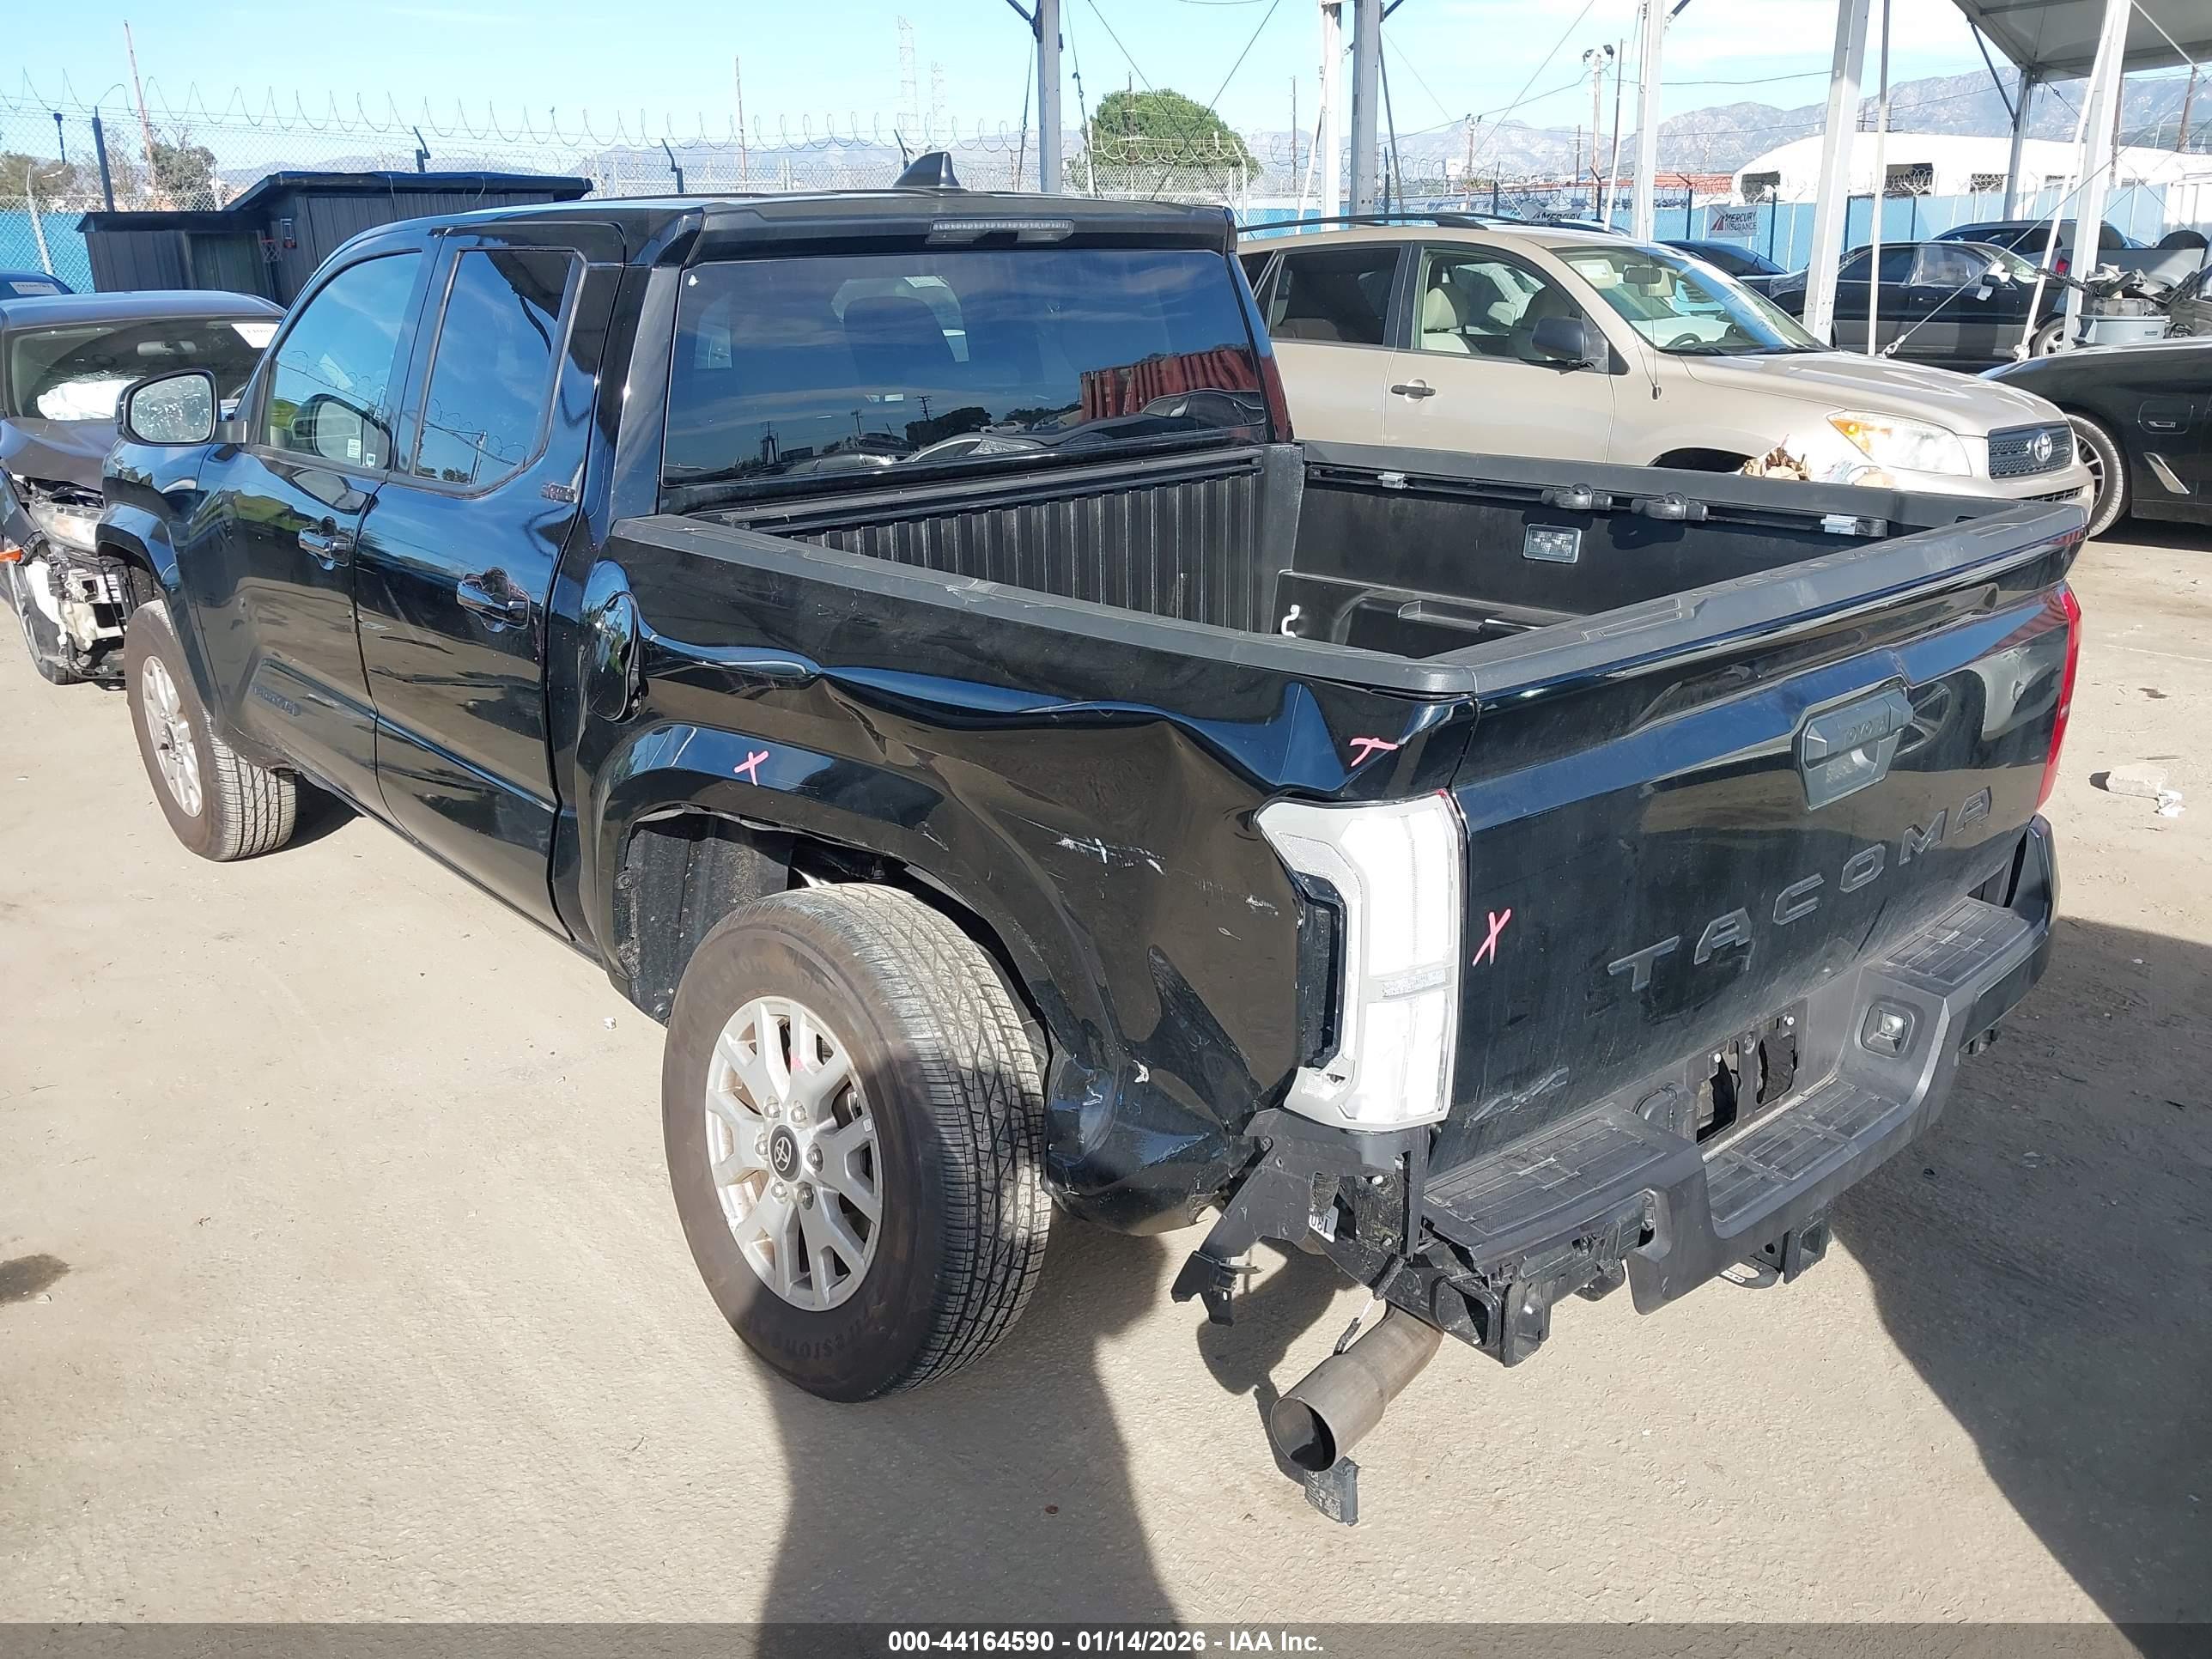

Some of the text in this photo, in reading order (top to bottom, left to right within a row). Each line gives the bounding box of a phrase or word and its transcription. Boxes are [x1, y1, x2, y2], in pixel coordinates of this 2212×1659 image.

[1725, 211, 1757, 223] MERCURY
[1725, 222, 1758, 232] INSURANCE
[1607, 785, 1993, 993] TACOMA
